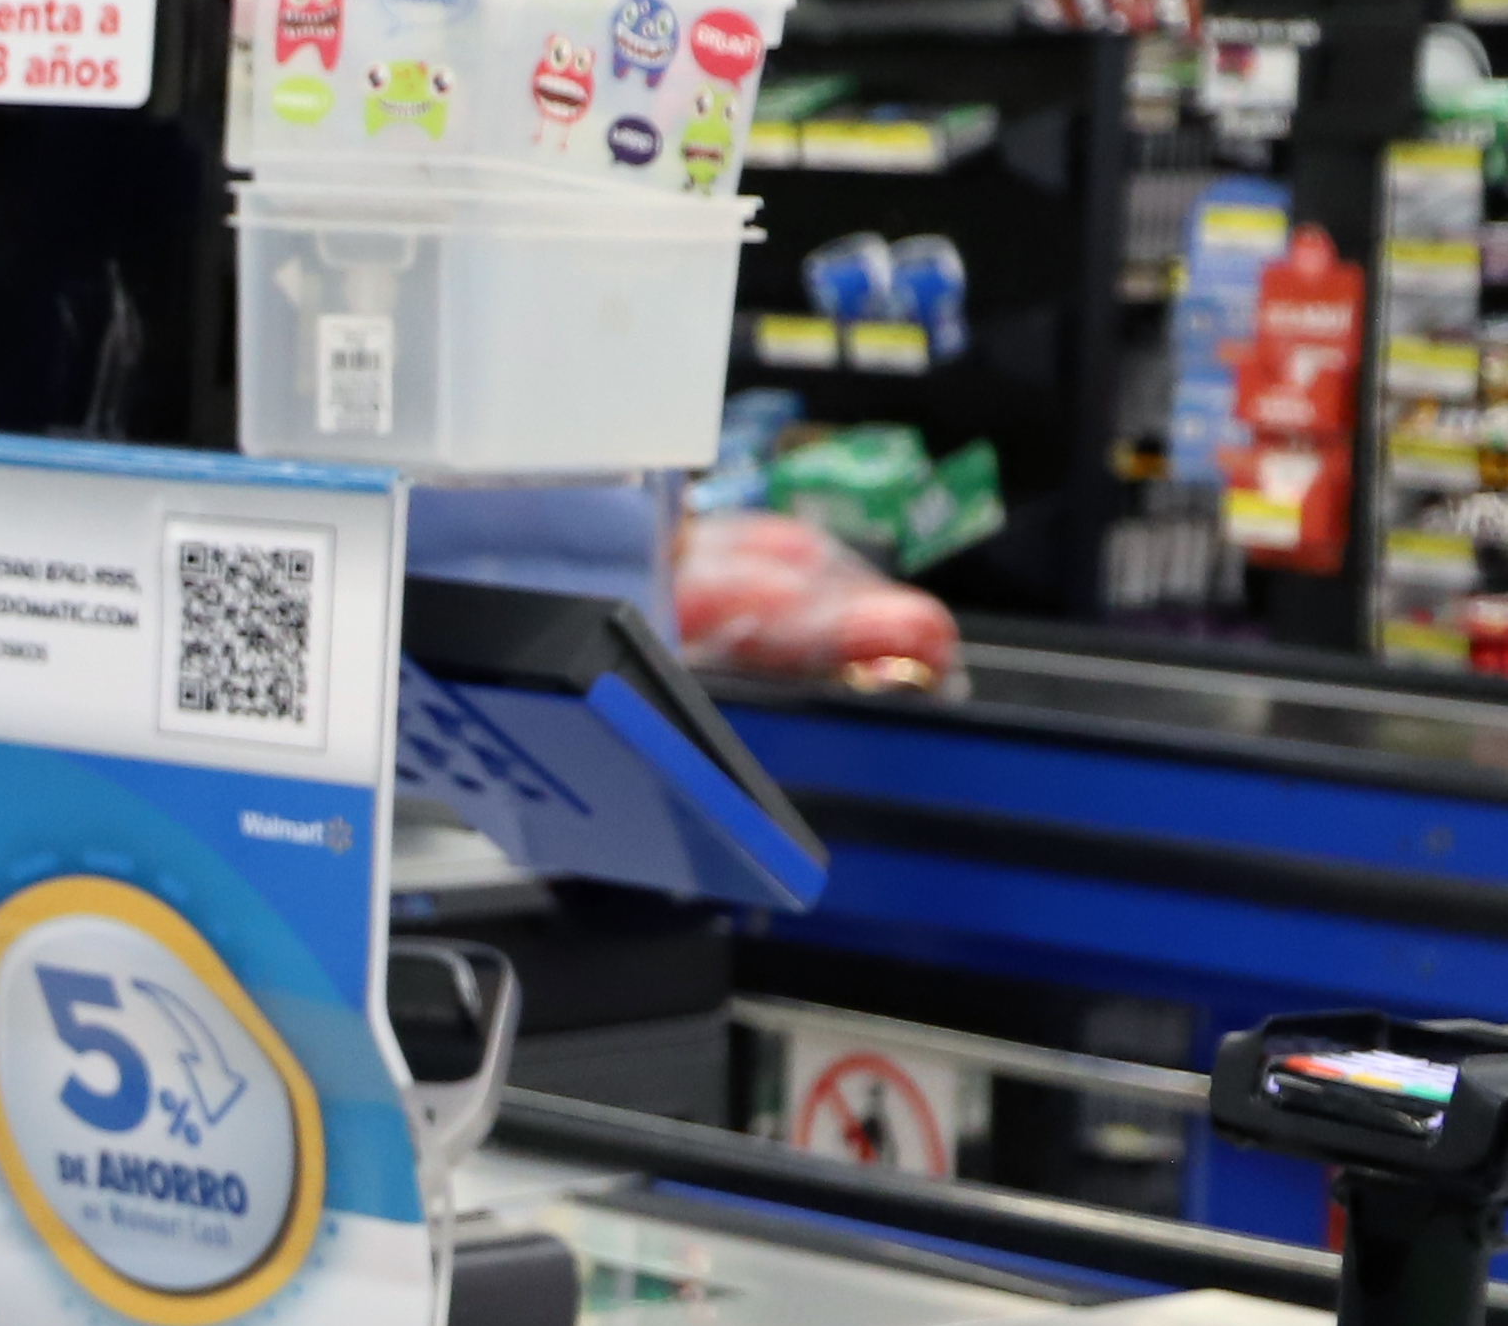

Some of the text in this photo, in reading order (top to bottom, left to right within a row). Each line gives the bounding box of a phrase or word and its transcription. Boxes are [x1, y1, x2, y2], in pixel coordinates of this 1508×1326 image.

[98, 5, 121, 36] a
[25, 48, 122, 90] años
[239, 810, 325, 847] Walmart
[97, 1149, 249, 1217] AHORRO
